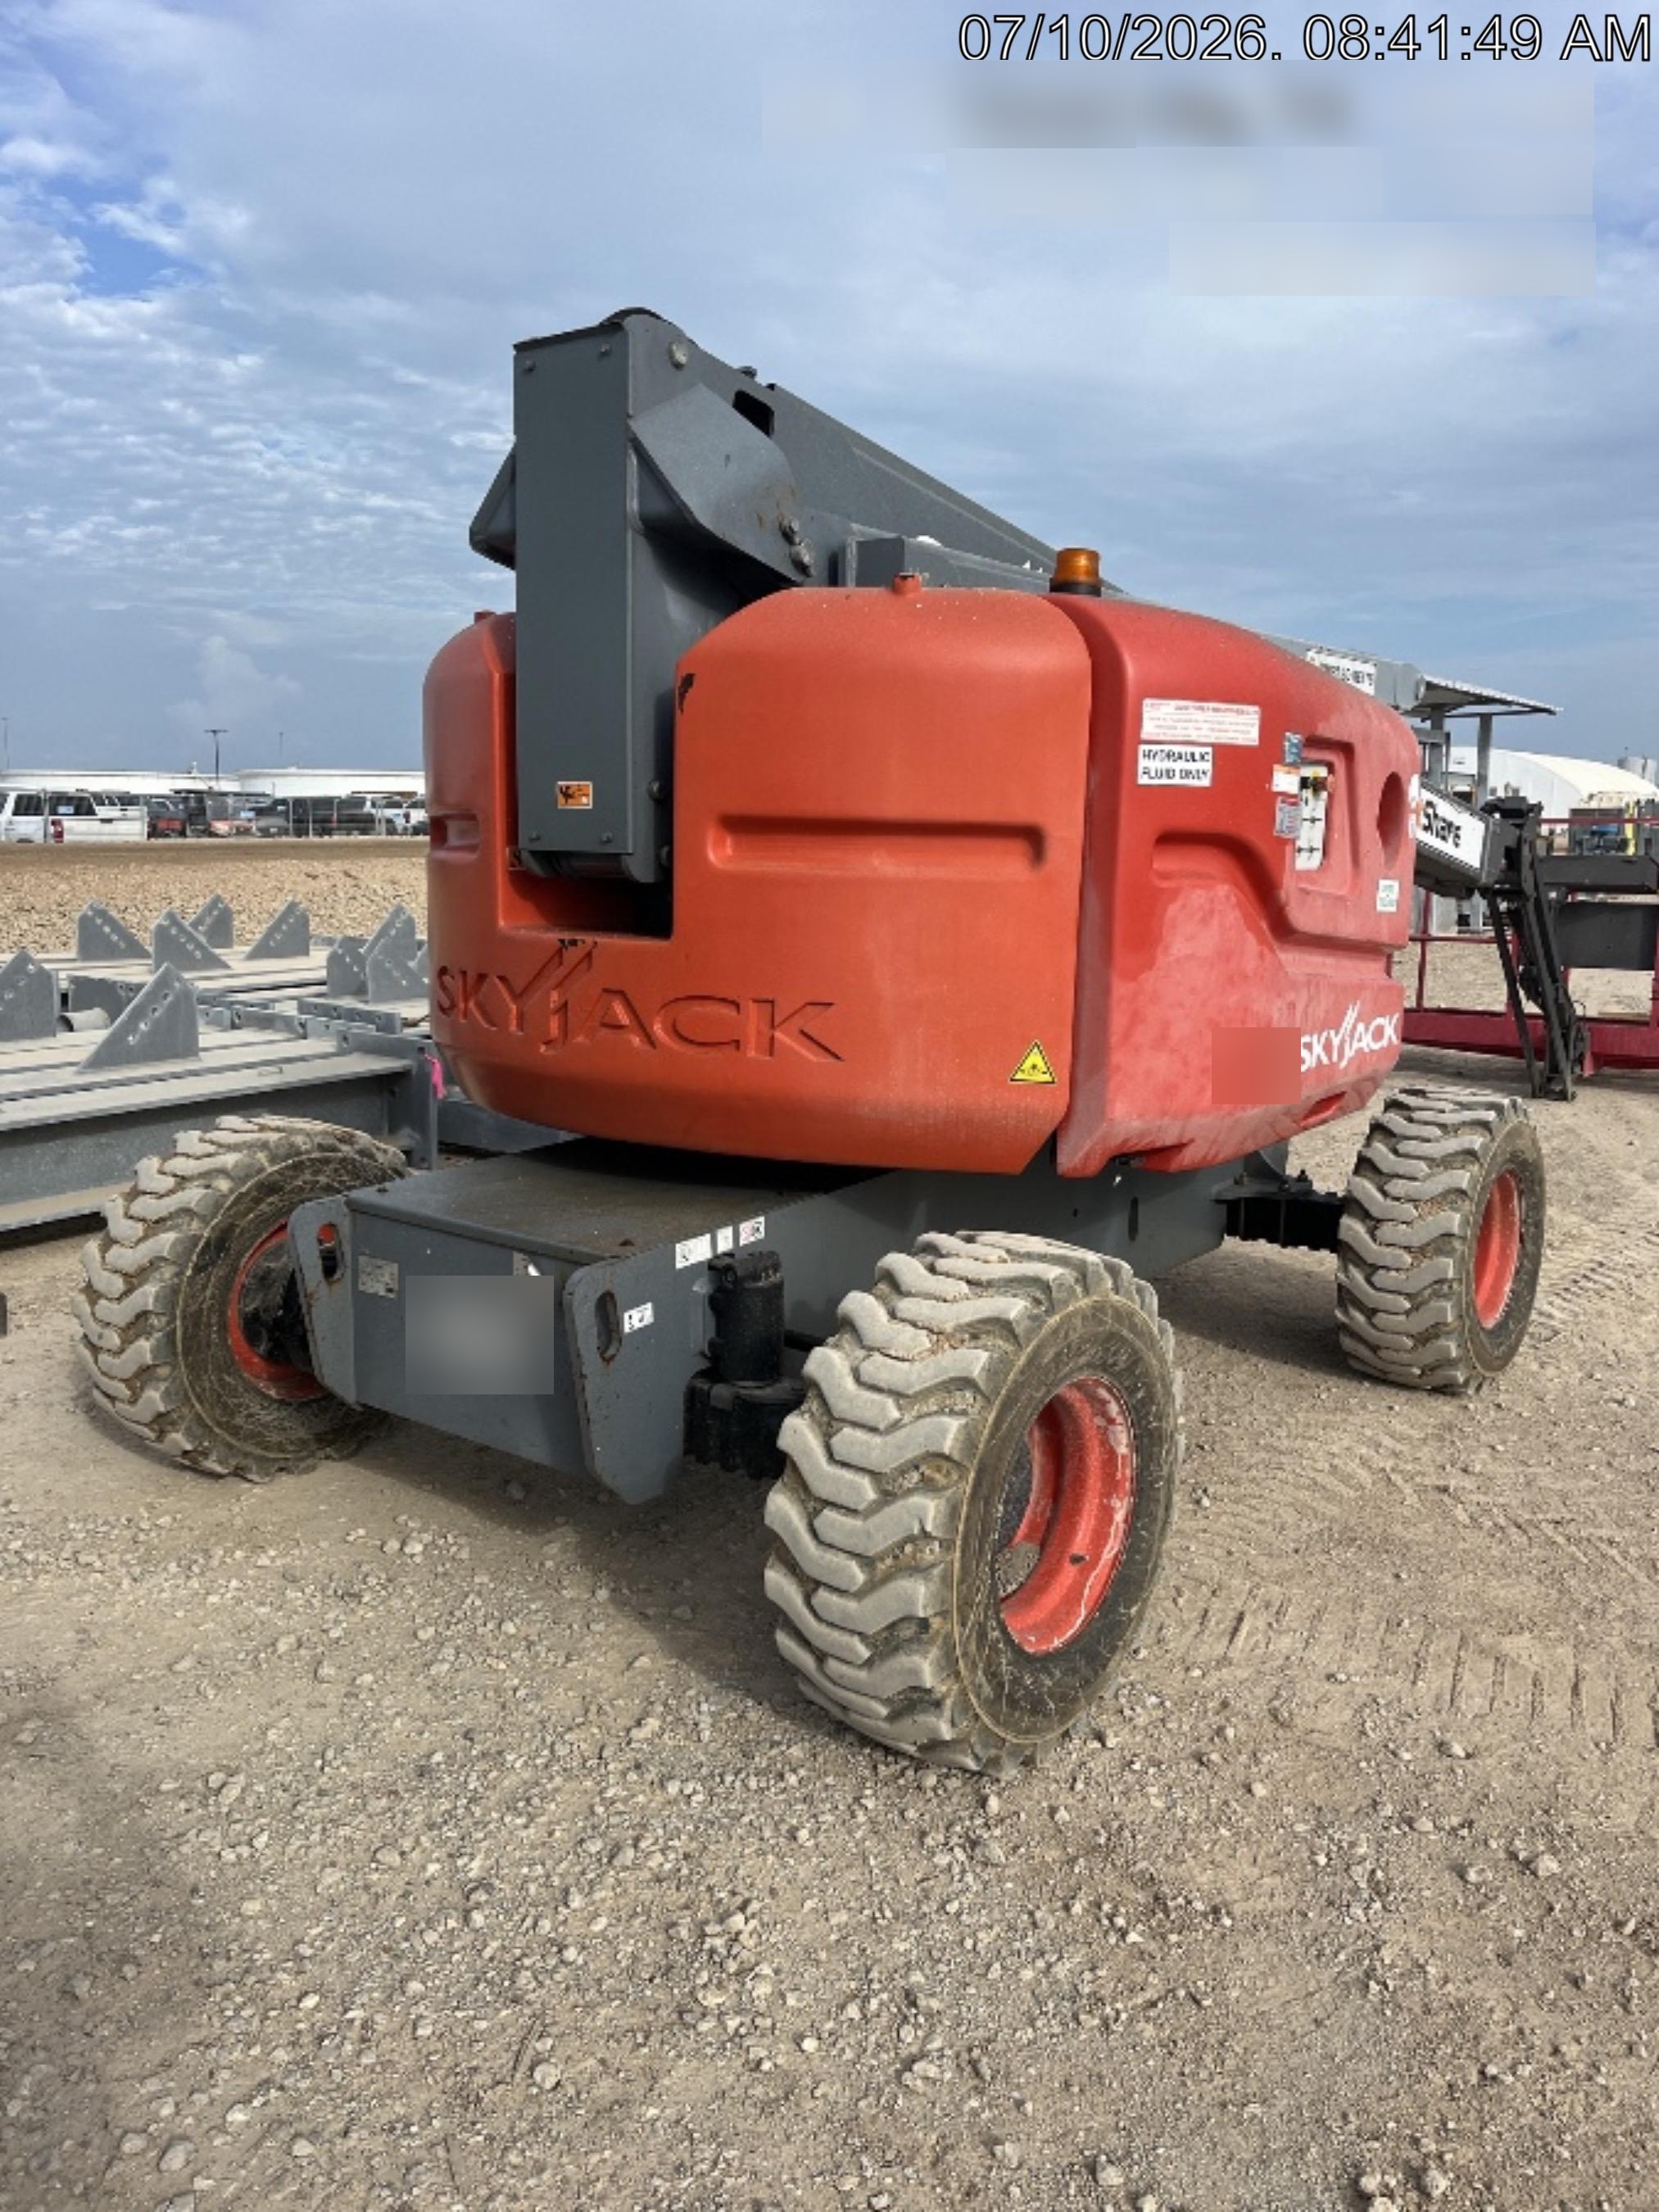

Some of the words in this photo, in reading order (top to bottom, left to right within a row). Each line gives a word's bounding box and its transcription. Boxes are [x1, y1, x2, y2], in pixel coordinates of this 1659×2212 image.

[1142, 749, 1210, 763] HYDRAULIC
[1142, 766, 1176, 780] FLUID
[1179, 767, 1210, 782] ONLY
[437, 940, 843, 1063] SKYJACK
[1301, 999, 1399, 1072] SKYJACK
